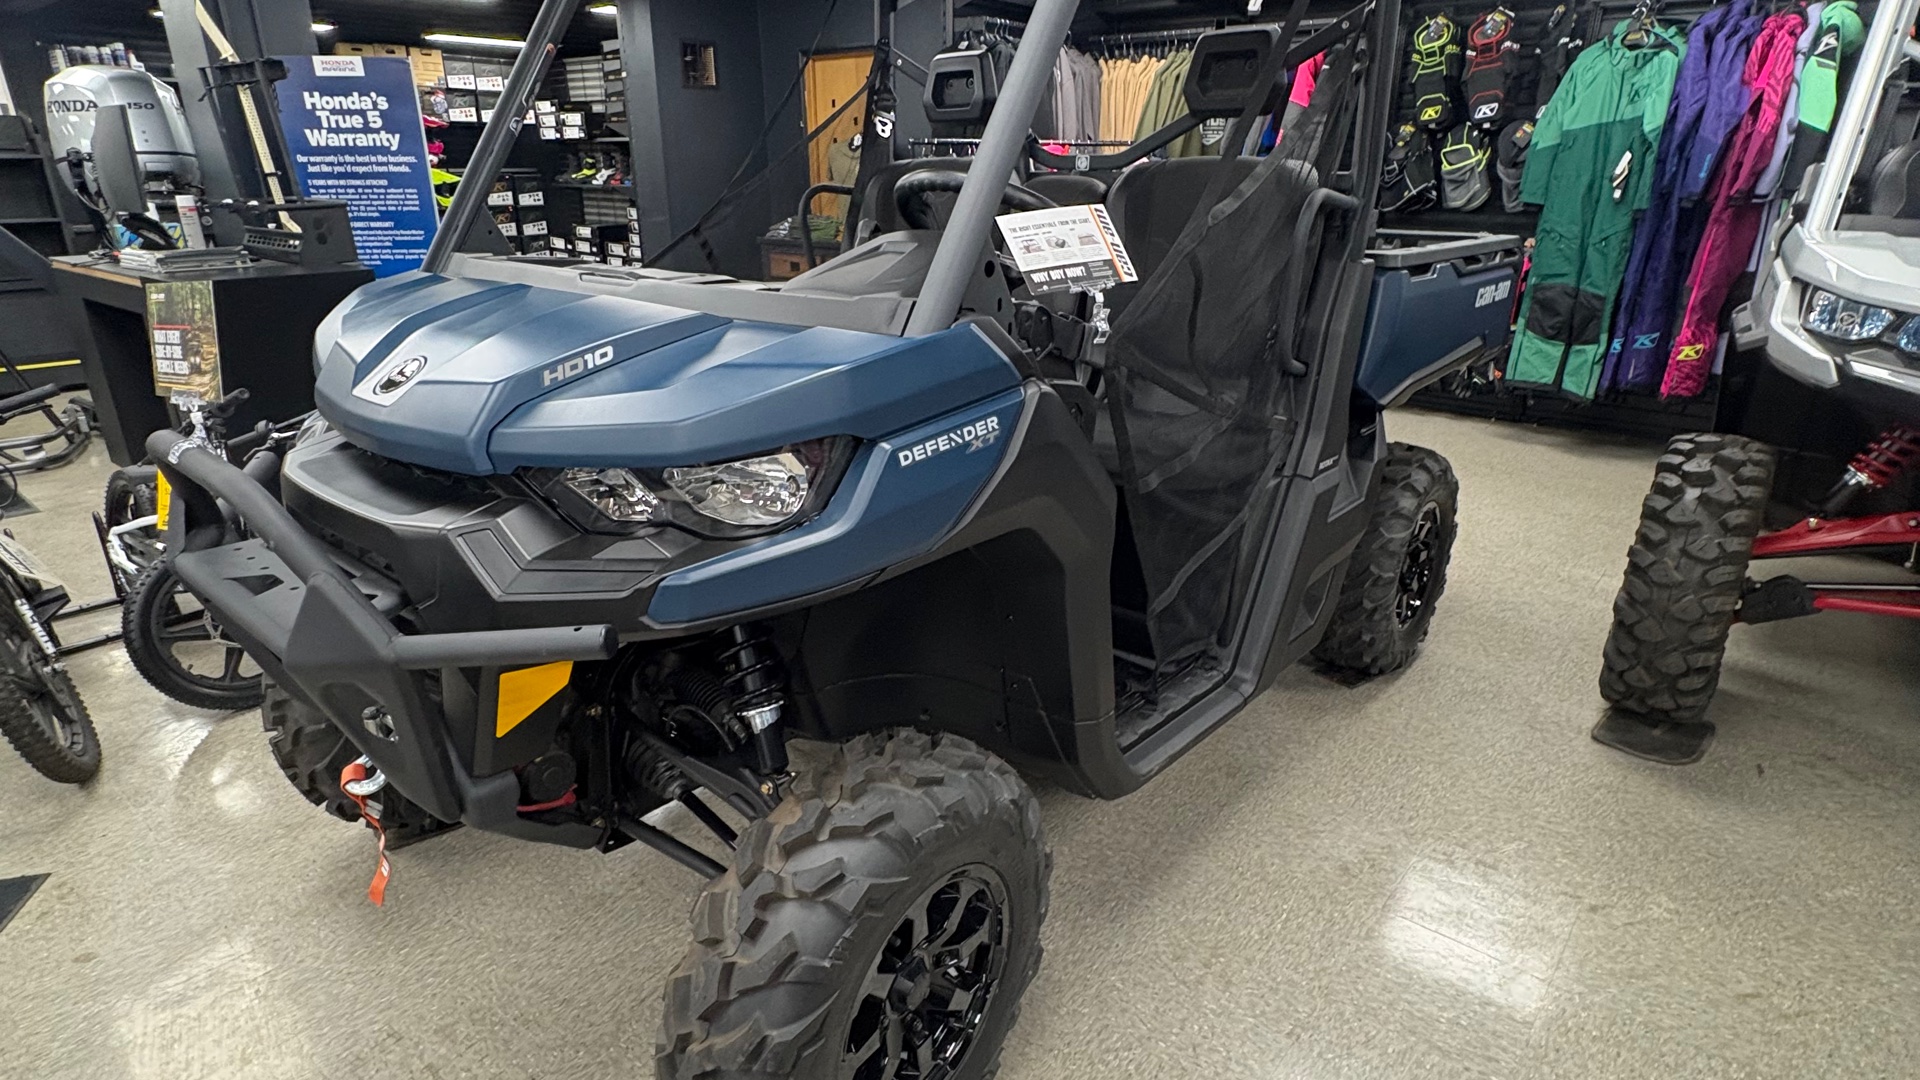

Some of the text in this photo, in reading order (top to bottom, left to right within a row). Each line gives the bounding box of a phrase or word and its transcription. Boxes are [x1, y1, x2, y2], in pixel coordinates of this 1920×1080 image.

[127, 102, 155, 110] 150
[303, 91, 389, 110] Honda's
[315, 110, 383, 128] True 5
[303, 128, 400, 151] Warranty
[296, 154, 418, 164] Our warranty is the best in the business.
[307, 164, 412, 174] Just like you'd expect from Honda.
[1030, 272, 1050, 283] WHY
[1050, 269, 1065, 281] BUY
[1065, 265, 1087, 279] NOW?
[543, 345, 614, 387] HD10
[898, 416, 999, 467] DEFENDER
[966, 430, 1000, 454] XT
